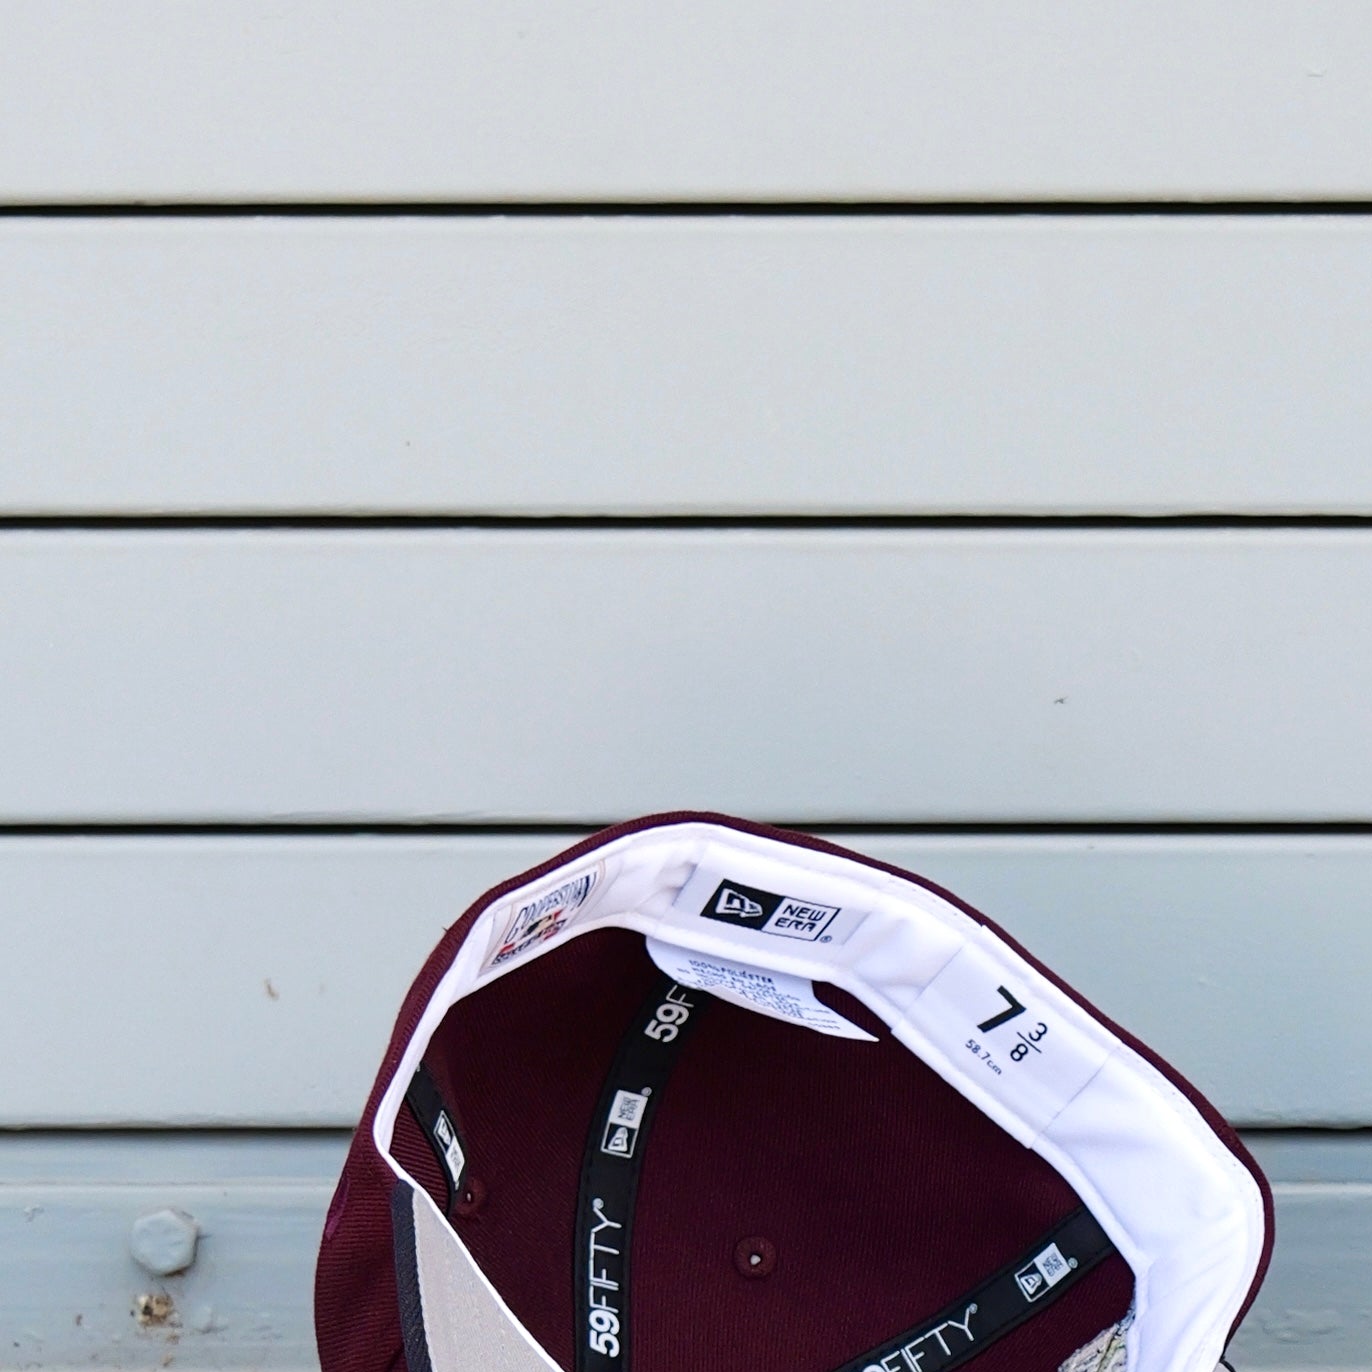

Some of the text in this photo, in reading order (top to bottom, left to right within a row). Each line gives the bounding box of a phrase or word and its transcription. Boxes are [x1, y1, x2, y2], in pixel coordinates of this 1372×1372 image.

[774, 917, 818, 933] ERA
[782, 904, 827, 922] NEW
[976, 985, 1027, 1033] 7
[588, 1204, 622, 1358] 59FIFTY
